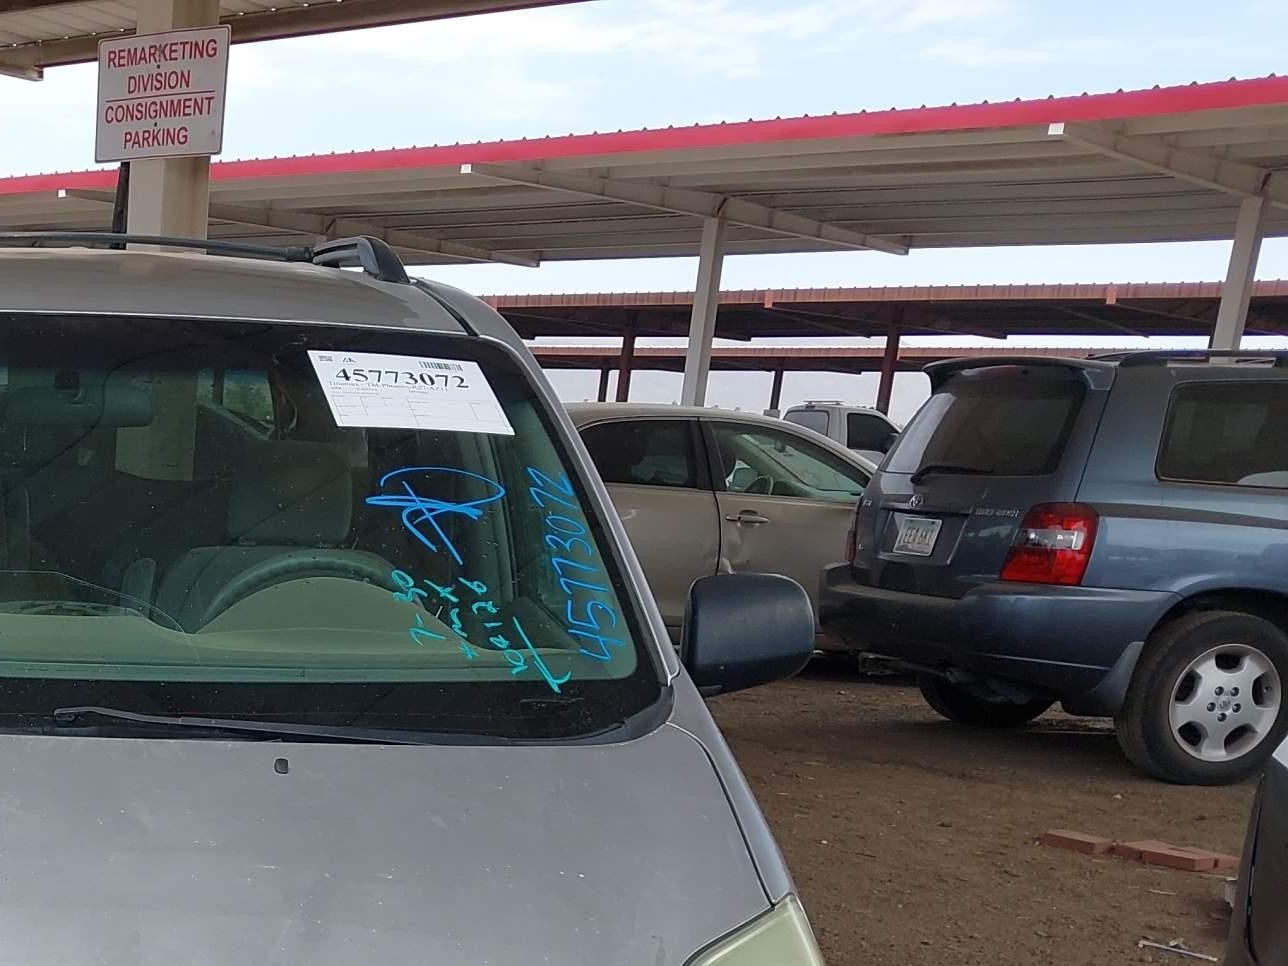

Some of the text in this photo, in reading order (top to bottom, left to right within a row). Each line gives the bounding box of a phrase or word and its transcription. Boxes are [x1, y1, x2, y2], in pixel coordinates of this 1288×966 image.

[108, 39, 217, 69] REMARKETING
[128, 70, 191, 94] DIVISION
[105, 97, 214, 124] CONSIGNMENT
[124, 127, 188, 149] PARKING
[335, 368, 470, 389] 45773072
[525, 466, 627, 662] 45773072
